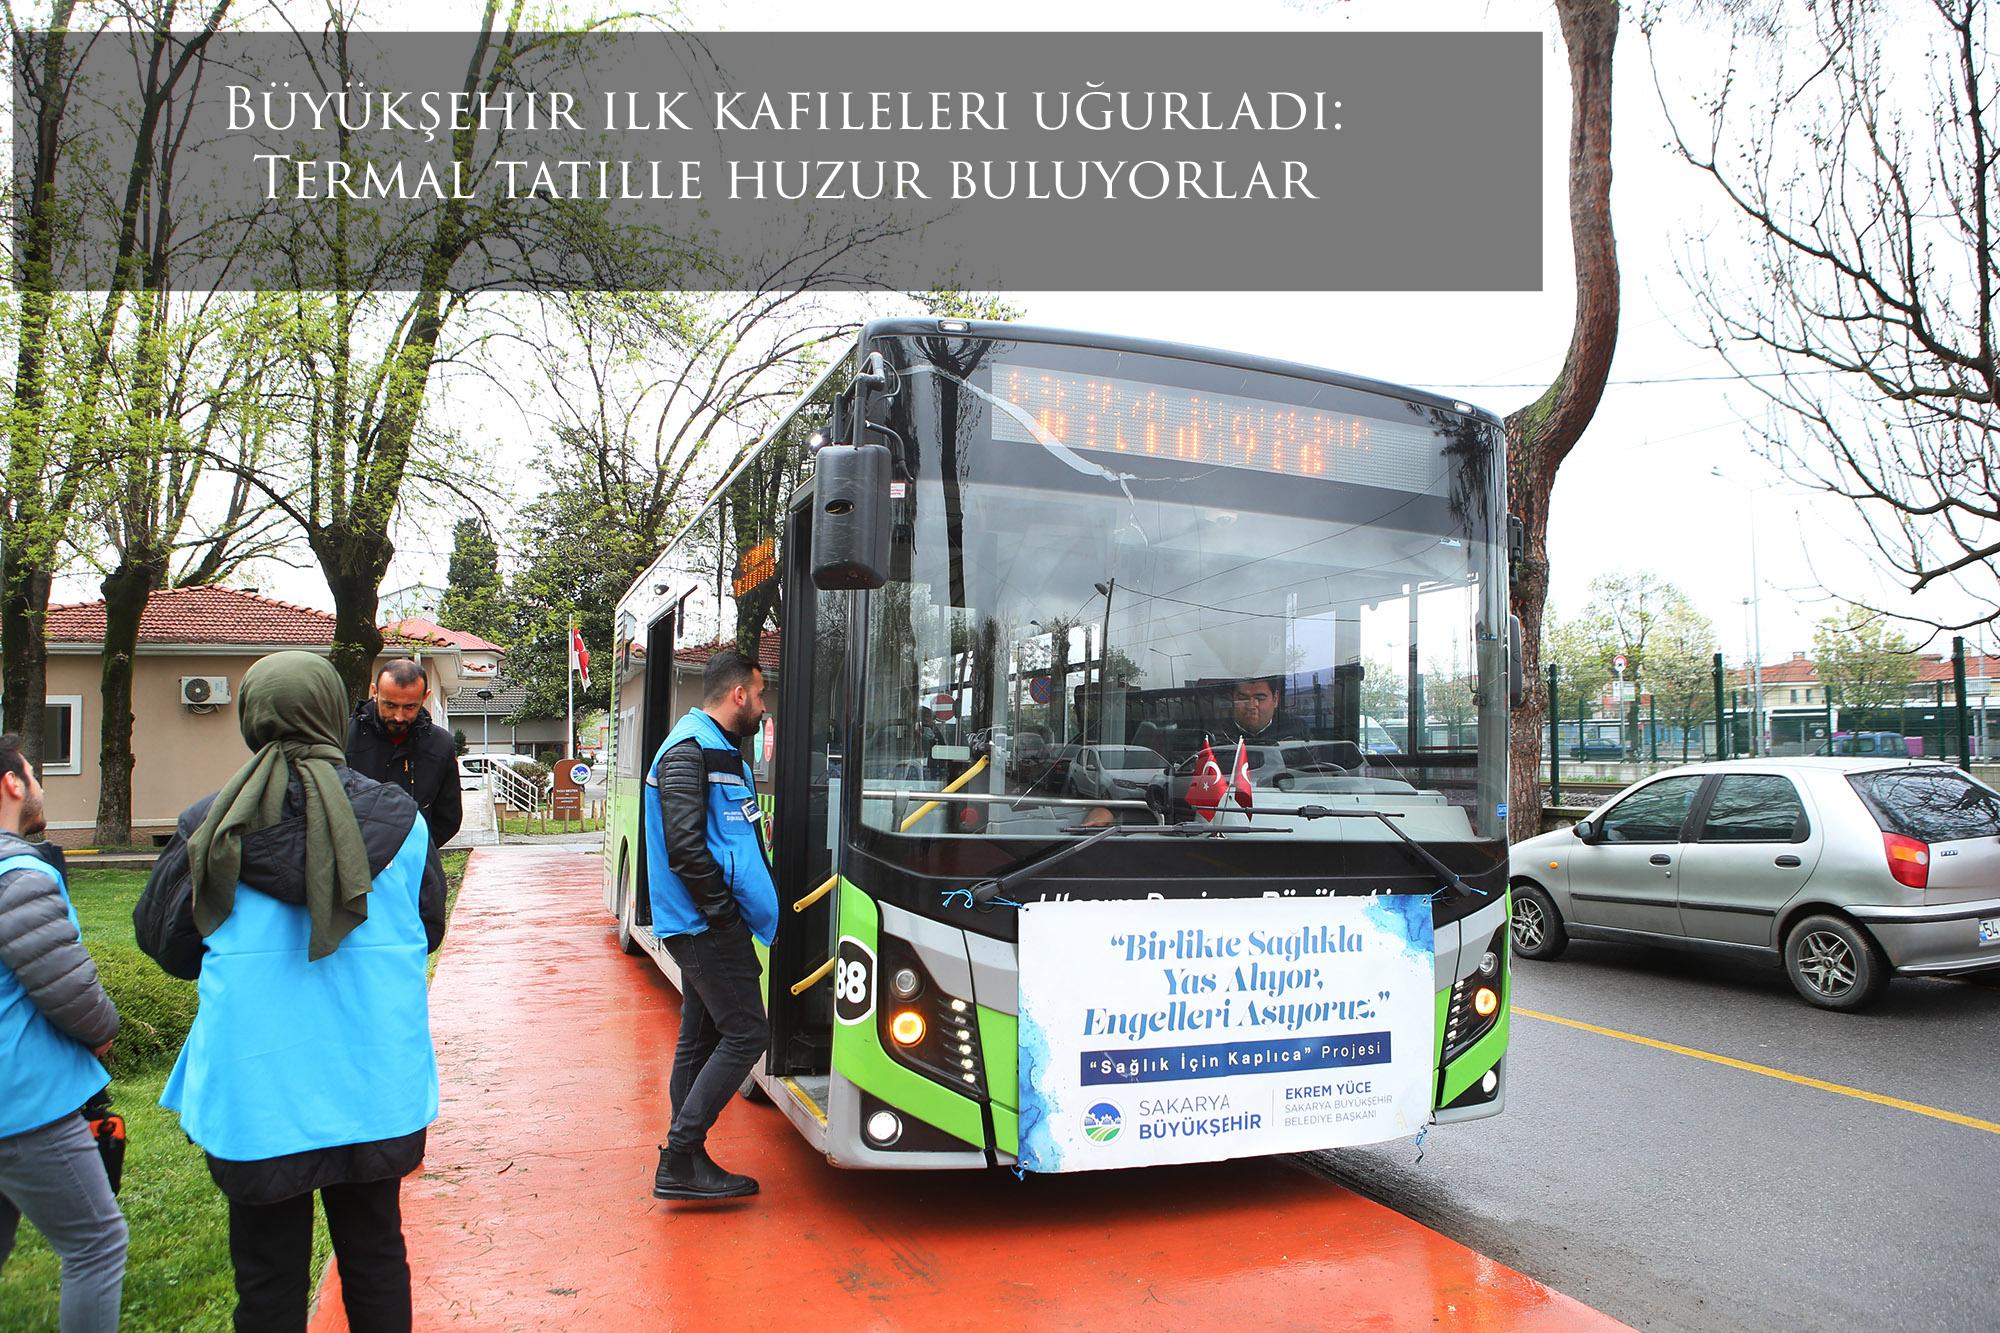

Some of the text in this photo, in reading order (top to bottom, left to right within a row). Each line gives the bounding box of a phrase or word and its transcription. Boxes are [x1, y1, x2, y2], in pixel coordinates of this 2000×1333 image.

[1983, 921, 1999, 937] 54
[1111, 925, 1363, 962] “Birlikte Sağlıkla
[1225, 962, 1324, 997] Alıyor,
[1082, 999, 1230, 1041] Engelleri
[1089, 1041, 1381, 1076] “Sağlık İçin Kaplıca” Projesi
[1285, 1080, 1372, 1100] EKREM YÜCE
[1139, 1094, 1230, 1116] SAKARYA
[1284, 1101, 1332, 1113] SAKARYA
[1139, 1111, 1261, 1139] BÜYÜKŞEHİR
[1284, 1109, 1377, 1127] BELEDİYE BAŞKANI
